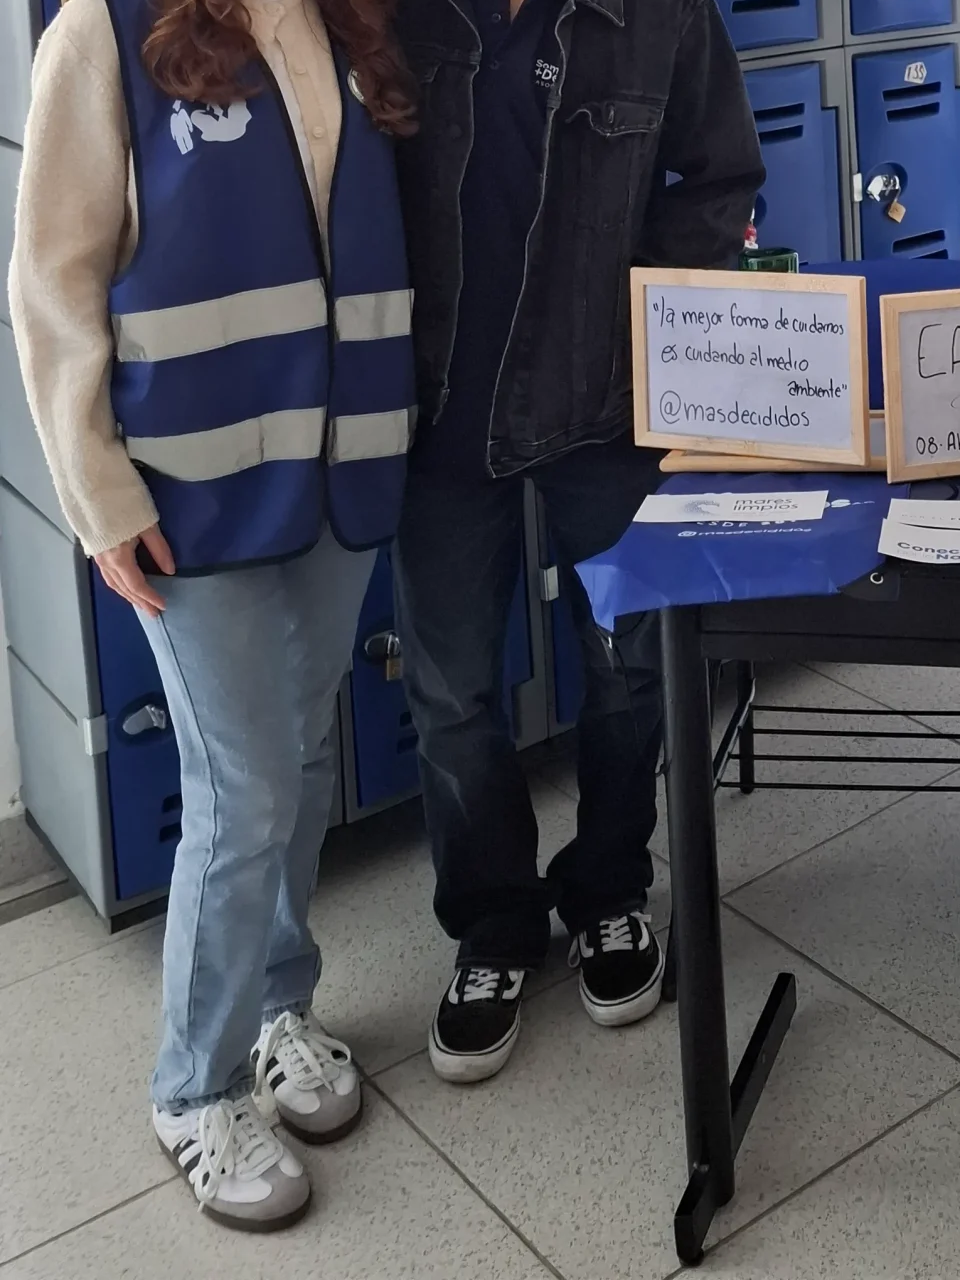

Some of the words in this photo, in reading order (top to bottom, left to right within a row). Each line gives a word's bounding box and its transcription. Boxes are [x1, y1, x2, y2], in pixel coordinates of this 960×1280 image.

[535, 58, 560, 75] Som
[682, 310, 724, 334] mejor
[730, 303, 769, 329] forma
[774, 307, 789, 331] de
[661, 343, 678, 363] es
[685, 340, 745, 365] cuidando
[749, 345, 763, 367] al
[766, 347, 809, 371] medio
[660, 390, 810, 428] @masdecididos
[732, 502, 799, 512] limpios
